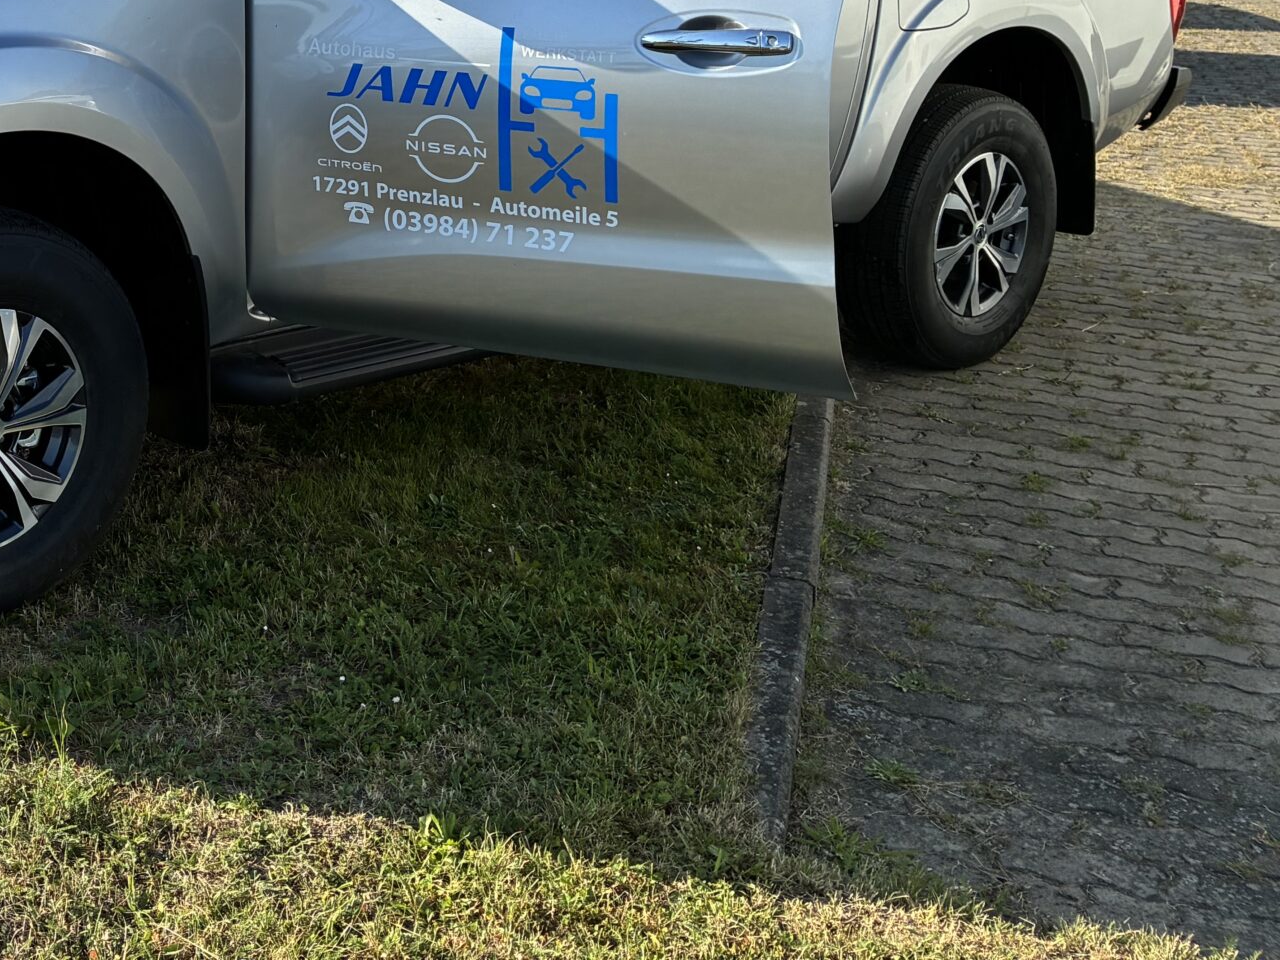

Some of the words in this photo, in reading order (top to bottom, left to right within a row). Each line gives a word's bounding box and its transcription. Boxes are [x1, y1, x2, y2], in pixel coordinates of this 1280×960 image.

[308, 38, 396, 59] Autohaus
[521, 45, 617, 63] WERKSTATT
[327, 63, 488, 110] JAHN
[406, 139, 487, 159] NISSAN
[312, 175, 369, 197] 17291
[376, 182, 463, 209] Prenzlau
[490, 196, 601, 227] Automeile
[605, 211, 618, 228] 5
[384, 207, 478, 244] (03984)
[486, 221, 514, 246] 71
[524, 227, 575, 253] 237
